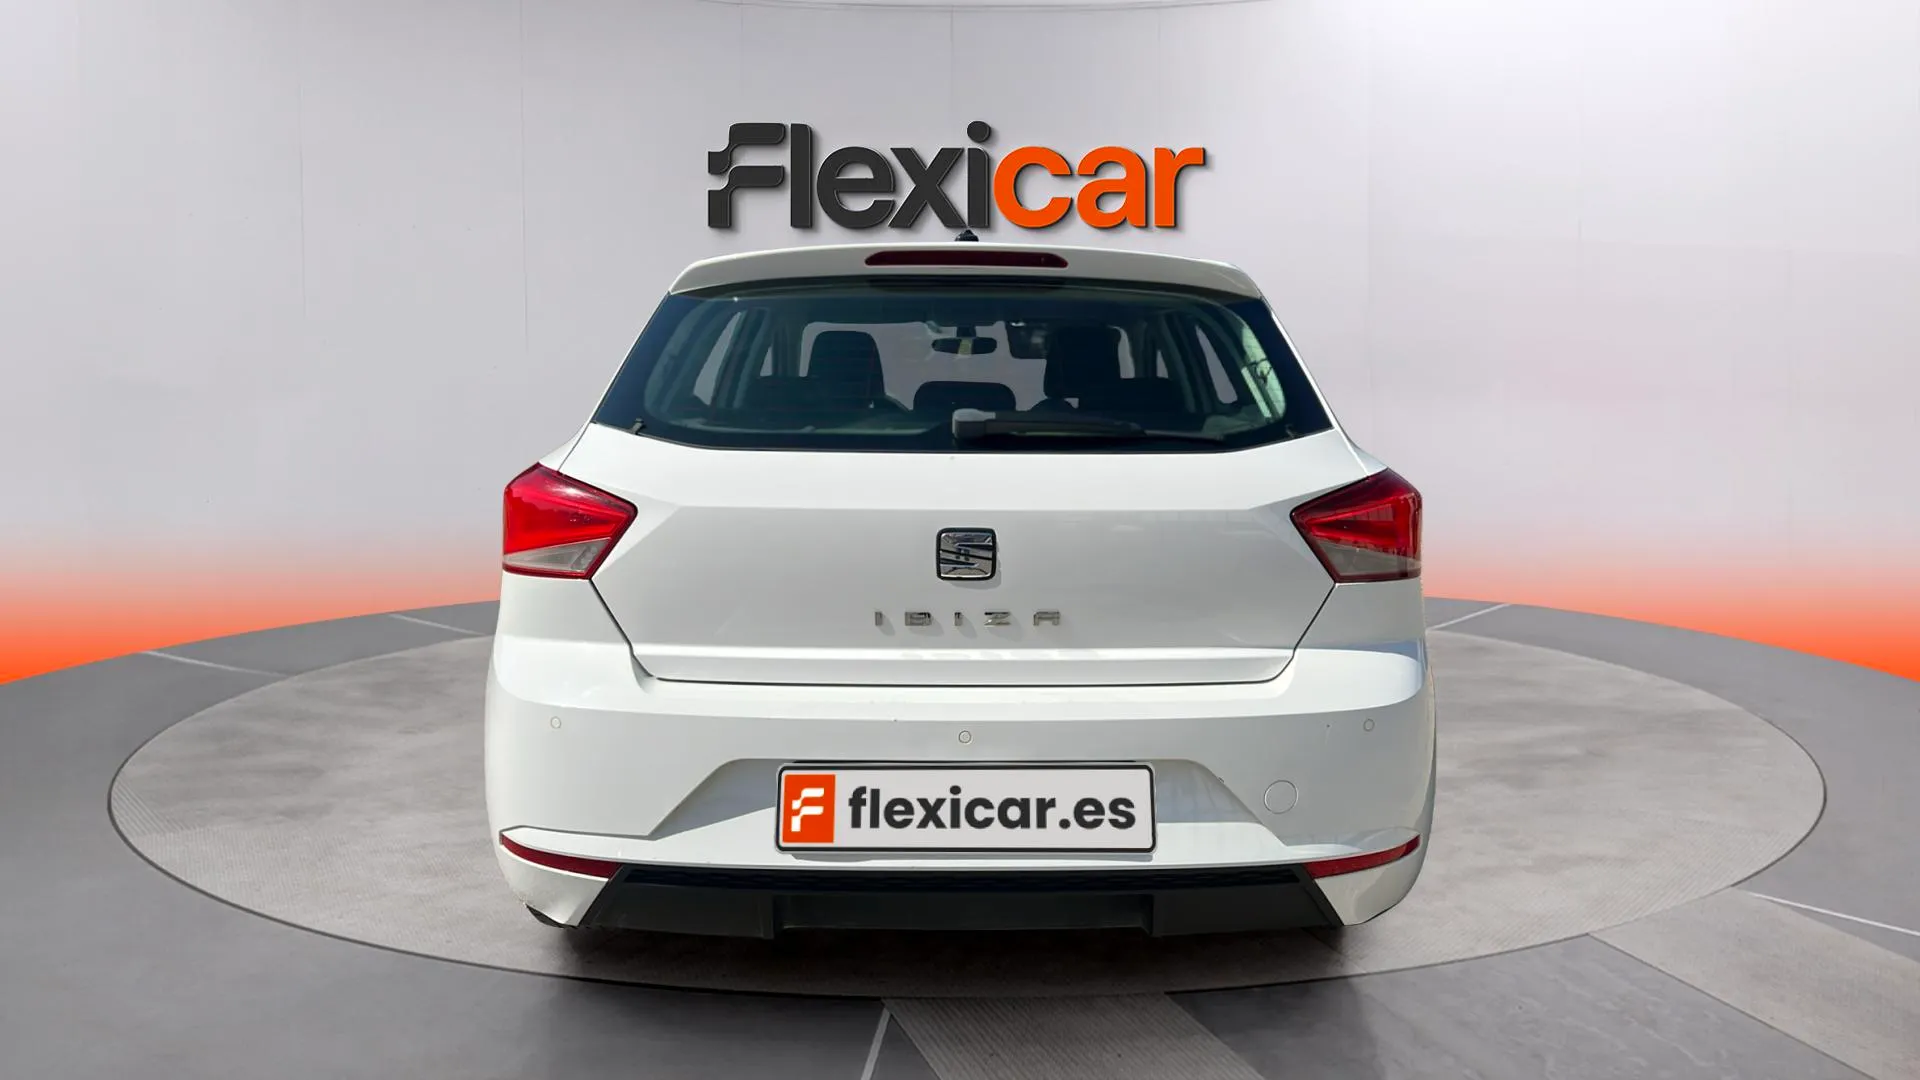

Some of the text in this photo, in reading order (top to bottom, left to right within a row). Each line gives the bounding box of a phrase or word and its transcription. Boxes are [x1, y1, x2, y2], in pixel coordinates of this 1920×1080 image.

[707, 120, 1205, 229] Flexicar
[874, 610, 1061, 627] IBIZA
[848, 785, 1136, 830] flexicar.es
